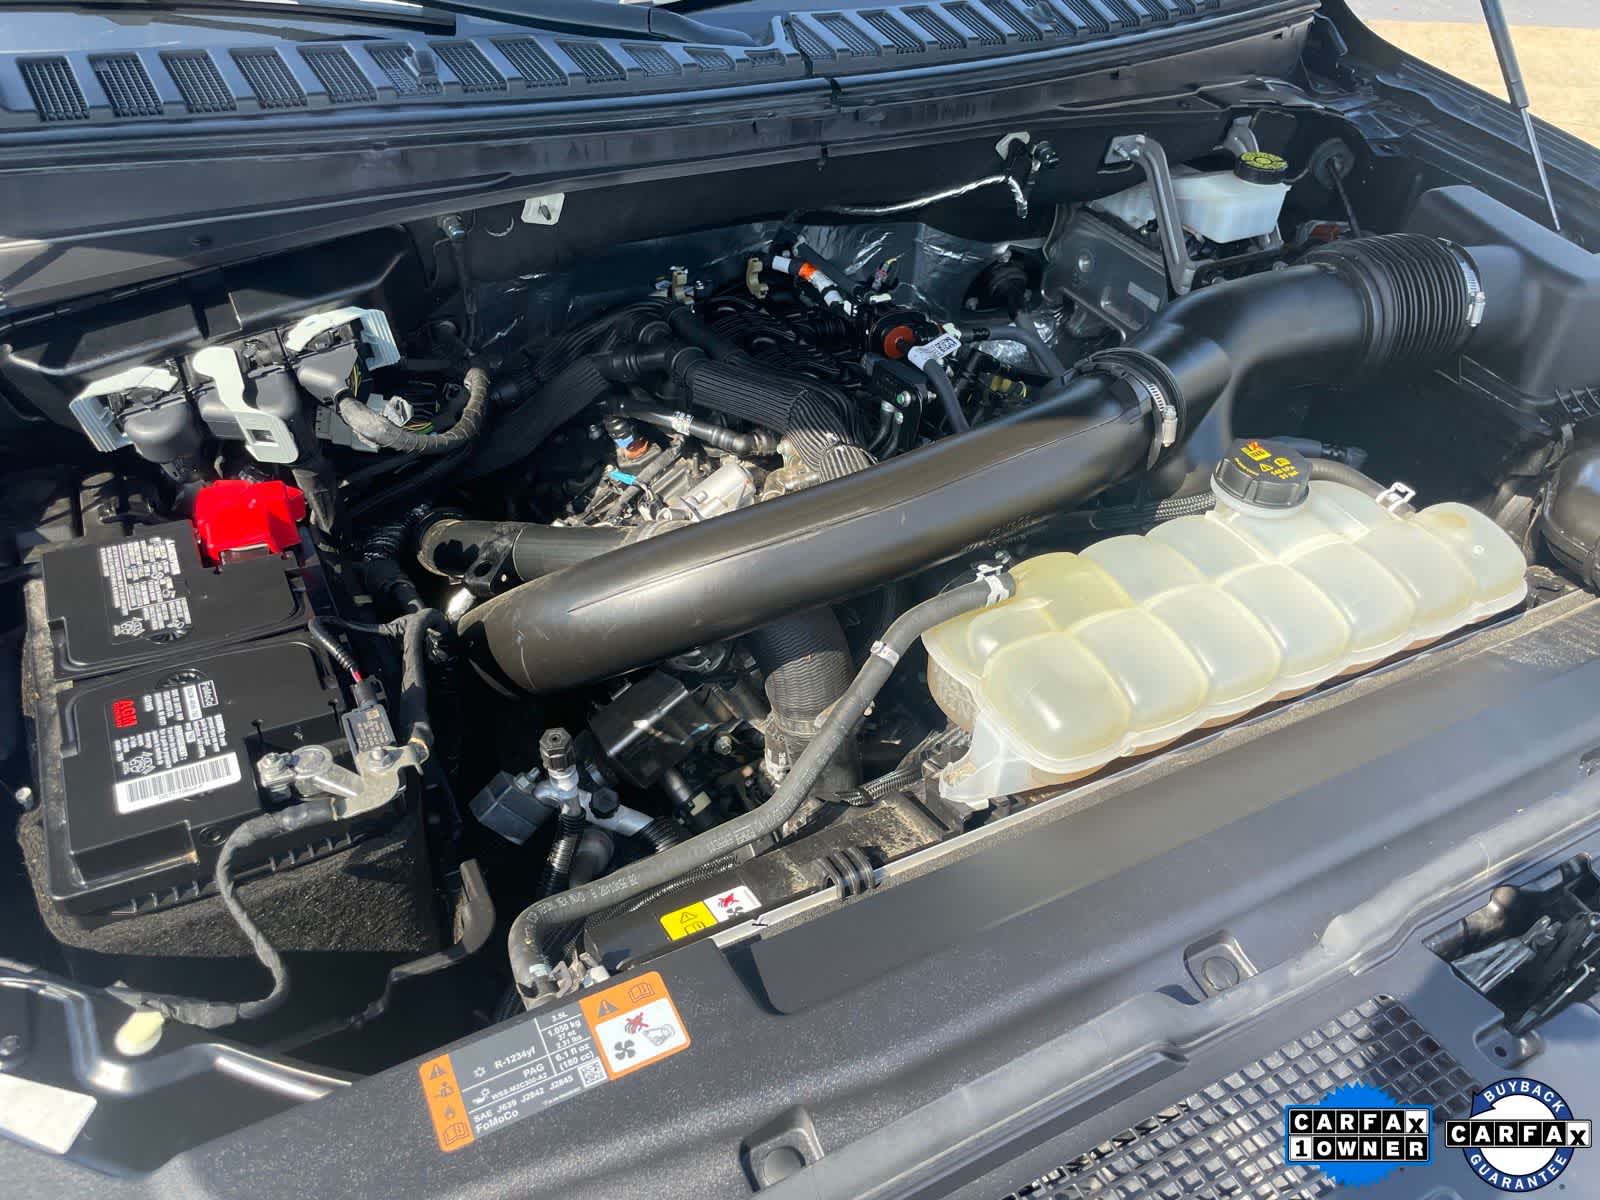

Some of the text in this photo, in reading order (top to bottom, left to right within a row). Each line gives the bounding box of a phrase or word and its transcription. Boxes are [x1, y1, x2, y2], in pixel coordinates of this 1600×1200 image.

[119, 699, 137, 726] AGM
[570, 1019, 581, 1029] kg
[494, 1045, 536, 1069] R-1234yf
[555, 1043, 591, 1062] 6.1 fl oz
[559, 1050, 594, 1071] (180 cc)
[522, 1063, 545, 1078] PAG
[473, 1109, 493, 1123] SAE
[497, 1099, 517, 1113] J639
[476, 1110, 519, 1134] FoMoCo
